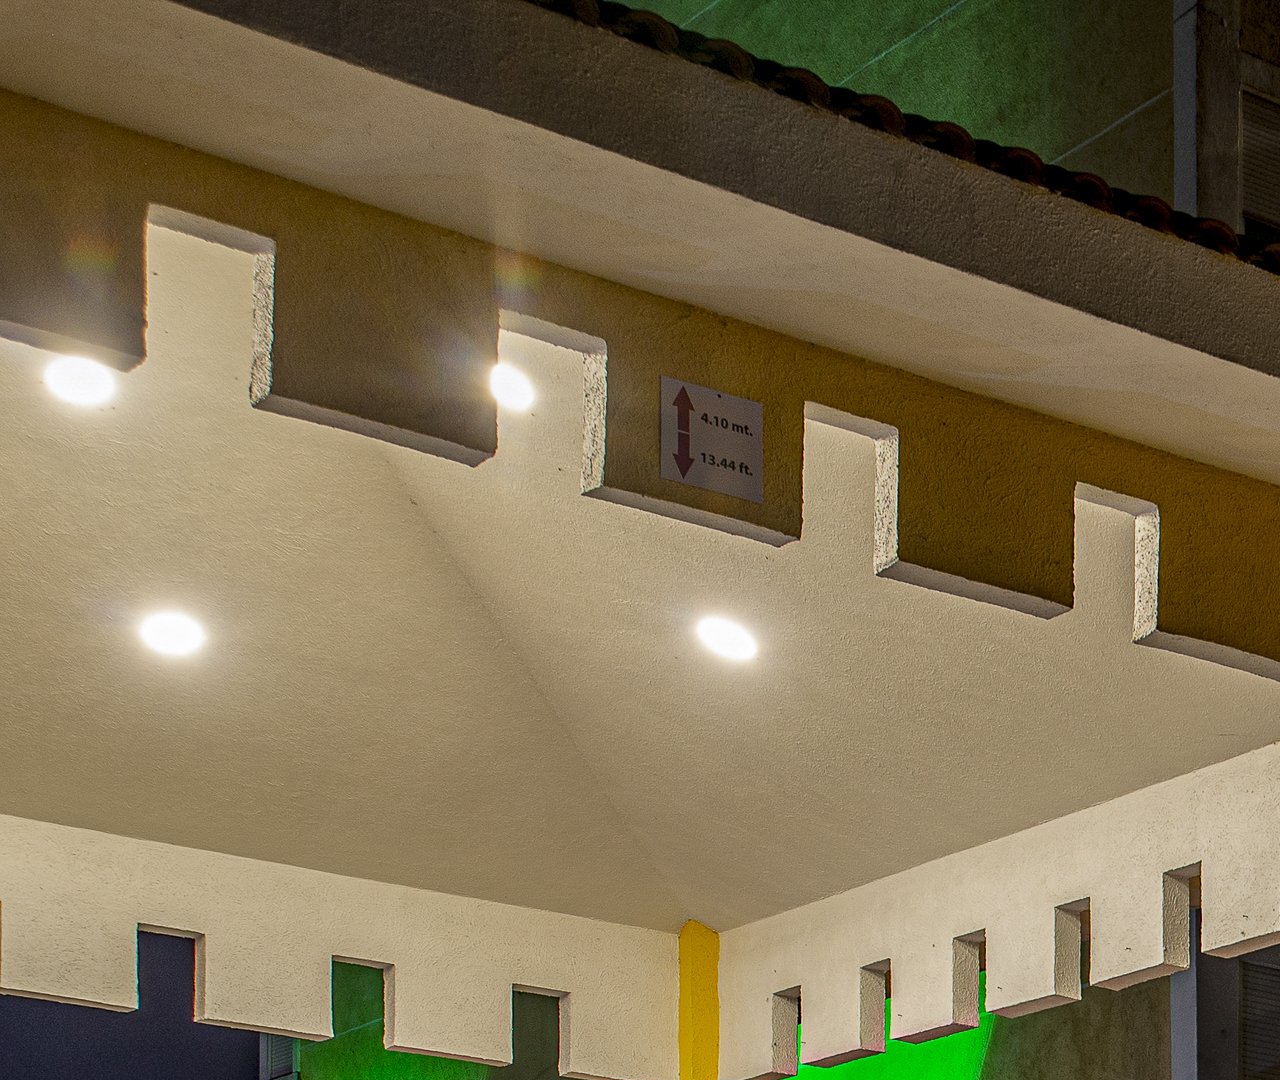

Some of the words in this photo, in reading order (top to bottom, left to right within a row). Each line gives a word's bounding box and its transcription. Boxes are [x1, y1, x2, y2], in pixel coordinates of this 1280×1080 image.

[701, 412, 729, 429] 4.10
[731, 423, 753, 437] mt.
[700, 452, 735, 471] 13.44
[738, 461, 753, 476] ft.
